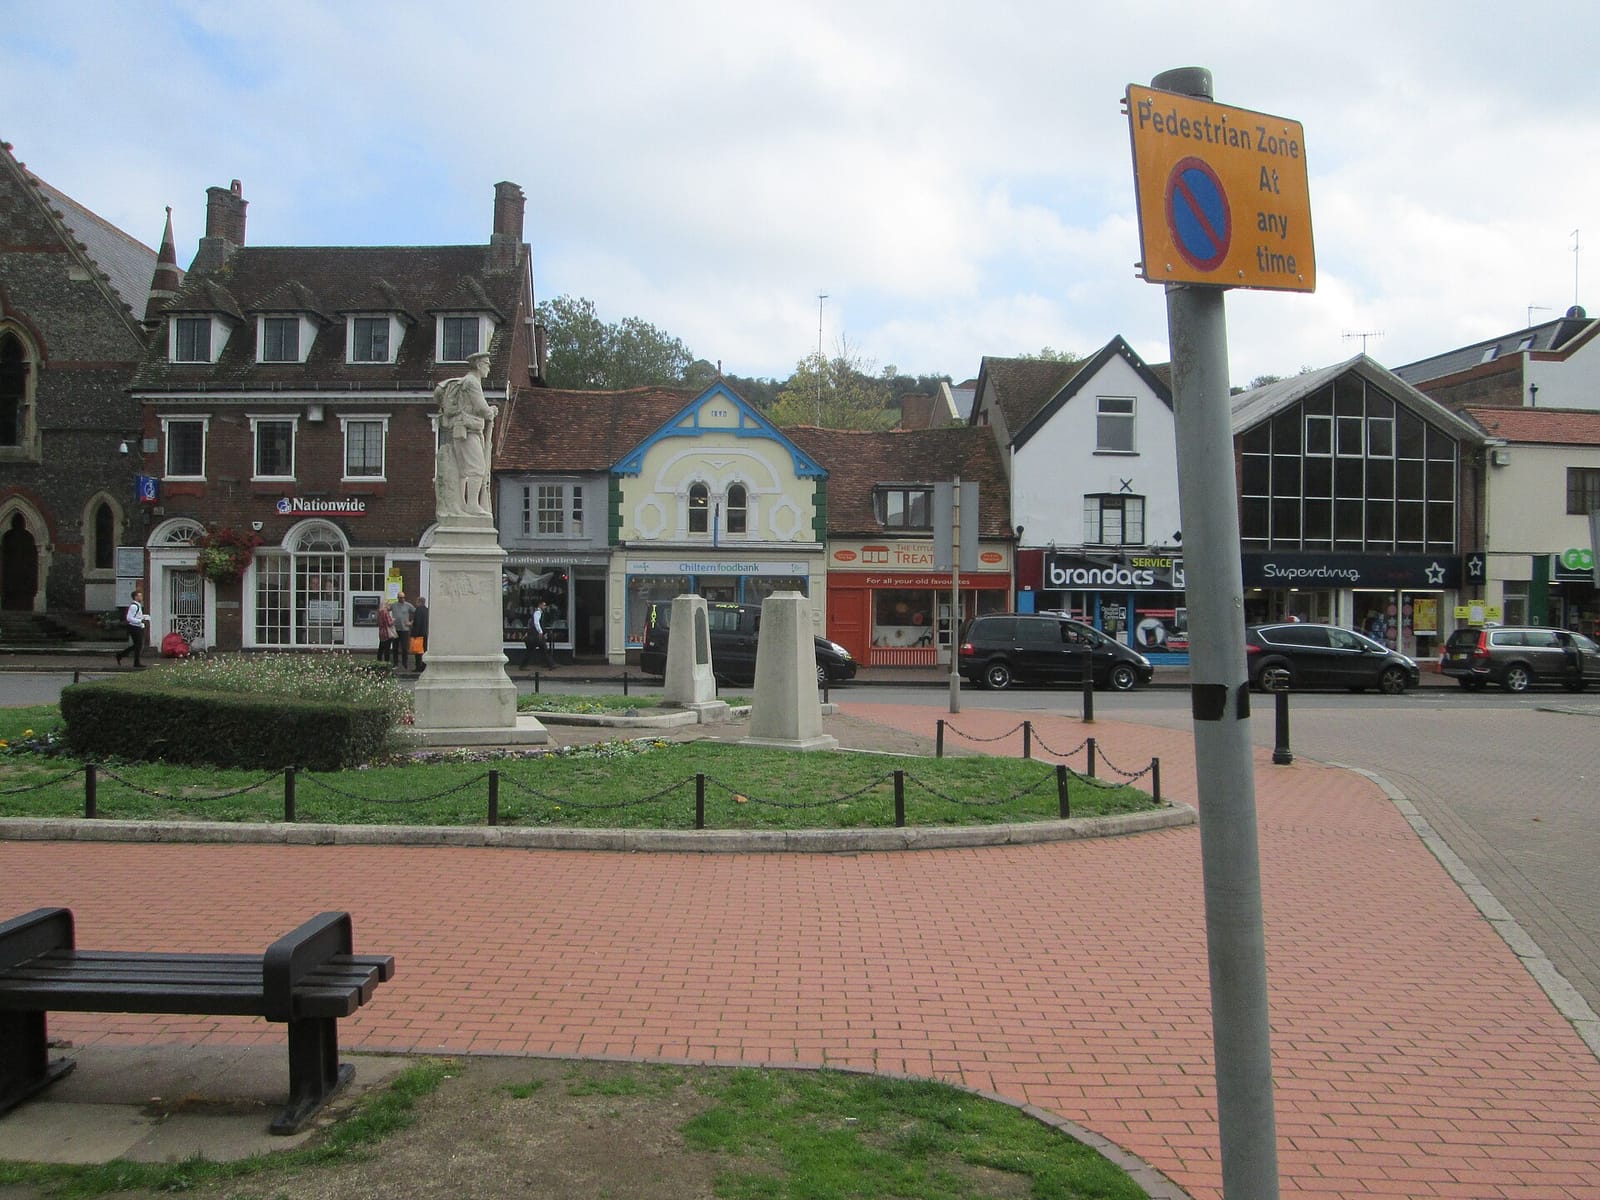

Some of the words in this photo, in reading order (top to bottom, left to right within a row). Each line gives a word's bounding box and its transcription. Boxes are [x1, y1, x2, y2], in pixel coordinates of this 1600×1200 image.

[1137, 101, 1251, 150] Pedestrian
[1256, 126, 1299, 159] Zone
[1259, 166, 1280, 195] At
[1257, 211, 1288, 239] any
[1256, 246, 1297, 274] time
[292, 497, 366, 511] Nationwide
[679, 562, 717, 572] Chiltern
[717, 562, 760, 572] foodbank
[1132, 557, 1172, 568] SERVICE
[1263, 563, 1361, 582] Superdrug
[866, 577, 881, 585] For
[883, 577, 893, 585] all
[893, 578, 914, 586] your
[915, 577, 929, 585] old
[931, 577, 971, 586] favoutes
[1050, 562, 1154, 586] brandacs
